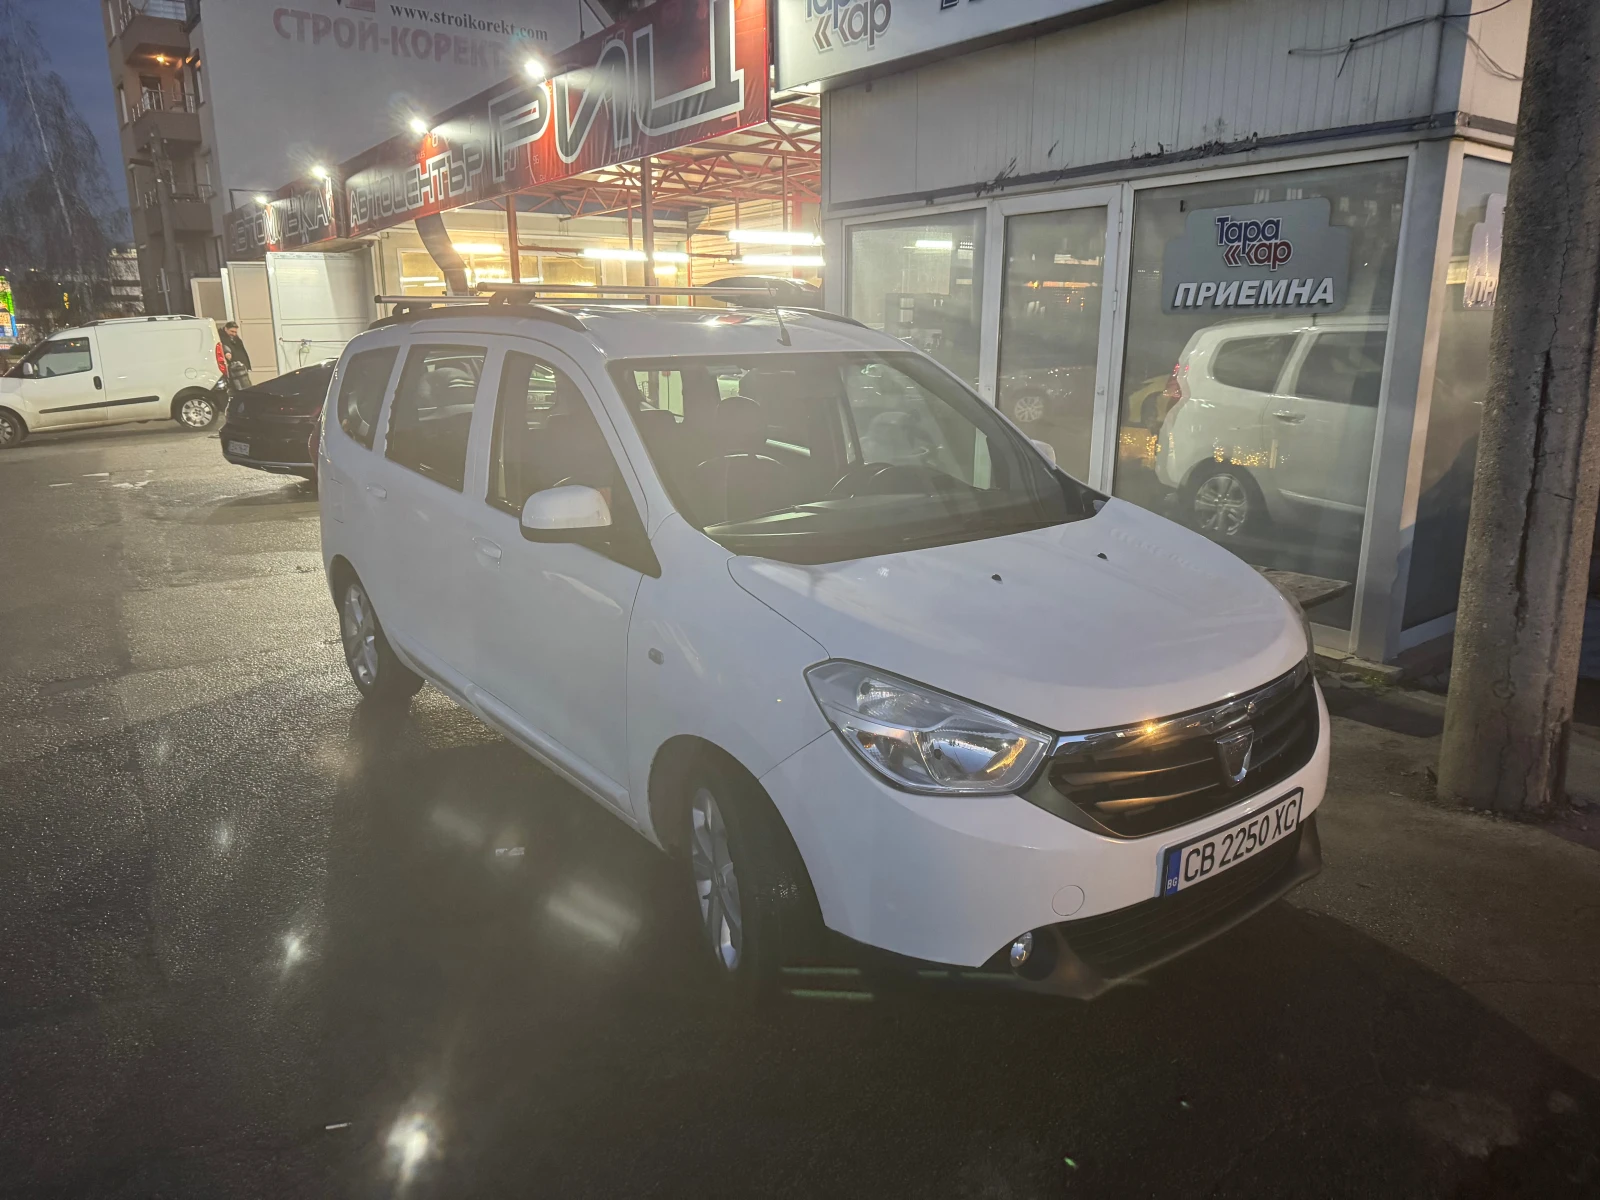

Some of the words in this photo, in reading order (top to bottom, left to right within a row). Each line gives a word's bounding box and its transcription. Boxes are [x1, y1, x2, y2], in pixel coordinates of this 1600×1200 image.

[390, 4, 549, 41] www.stroikorekt.com
[350, 141, 484, 228] АВТОЦЕНТЪР
[1216, 215, 1283, 255] Тара
[1174, 277, 1335, 307] ПРИЕМНА
[1184, 842, 1215, 883] CB
[1219, 815, 1270, 869] 2250
[1272, 799, 1297, 841] XC
[1167, 876, 1178, 890] BG
